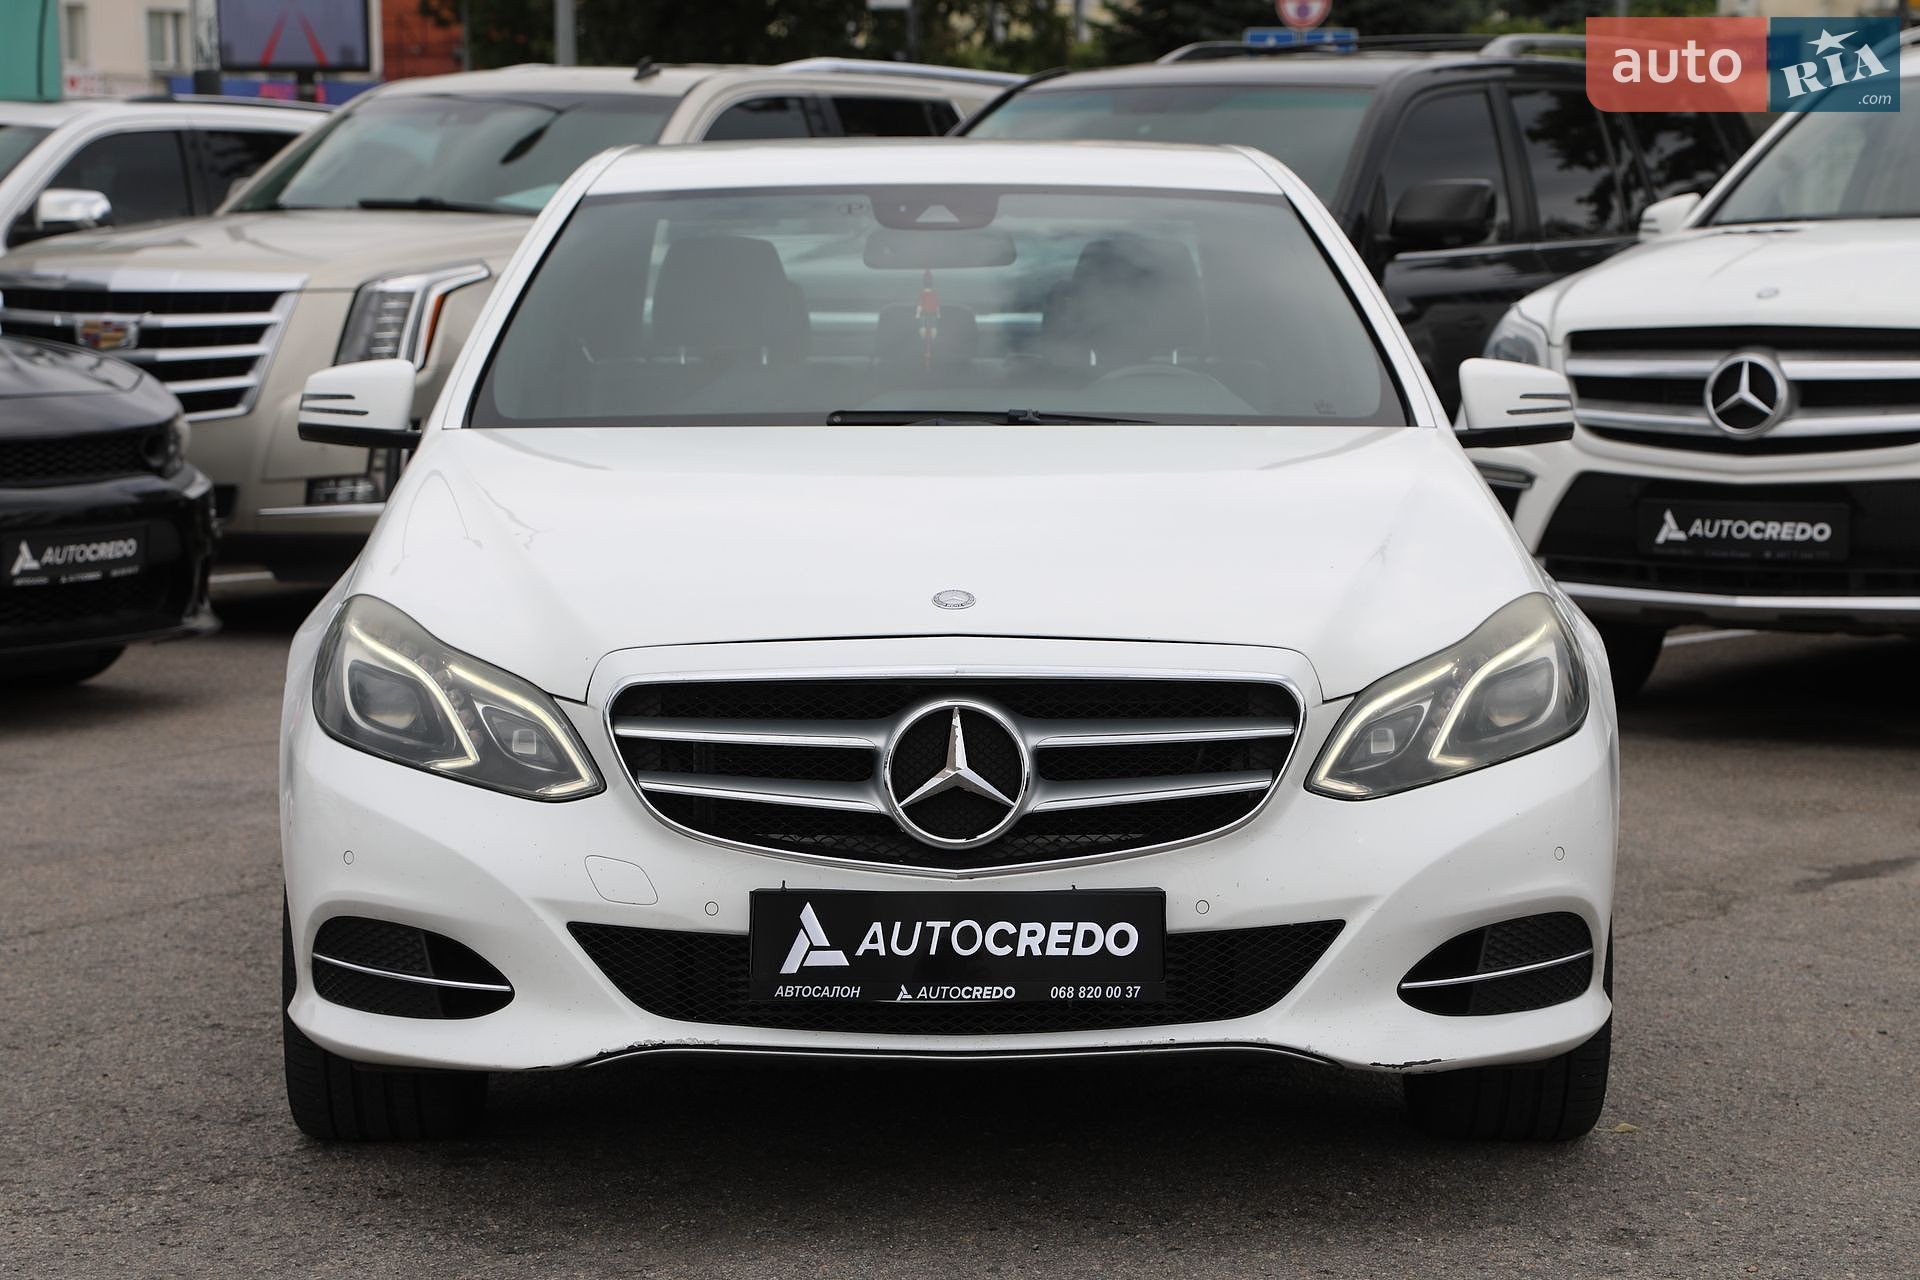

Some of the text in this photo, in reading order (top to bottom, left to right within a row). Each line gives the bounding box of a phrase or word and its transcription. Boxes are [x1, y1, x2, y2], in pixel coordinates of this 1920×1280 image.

[1687, 518, 1832, 542] AUTOCREDO
[855, 919, 1139, 957] AUTOCREDO
[774, 984, 861, 999] АВТОСАЛОН
[916, 985, 1017, 1001] AUTOCREDO
[1050, 985, 1142, 1000] 068 820 00 37
